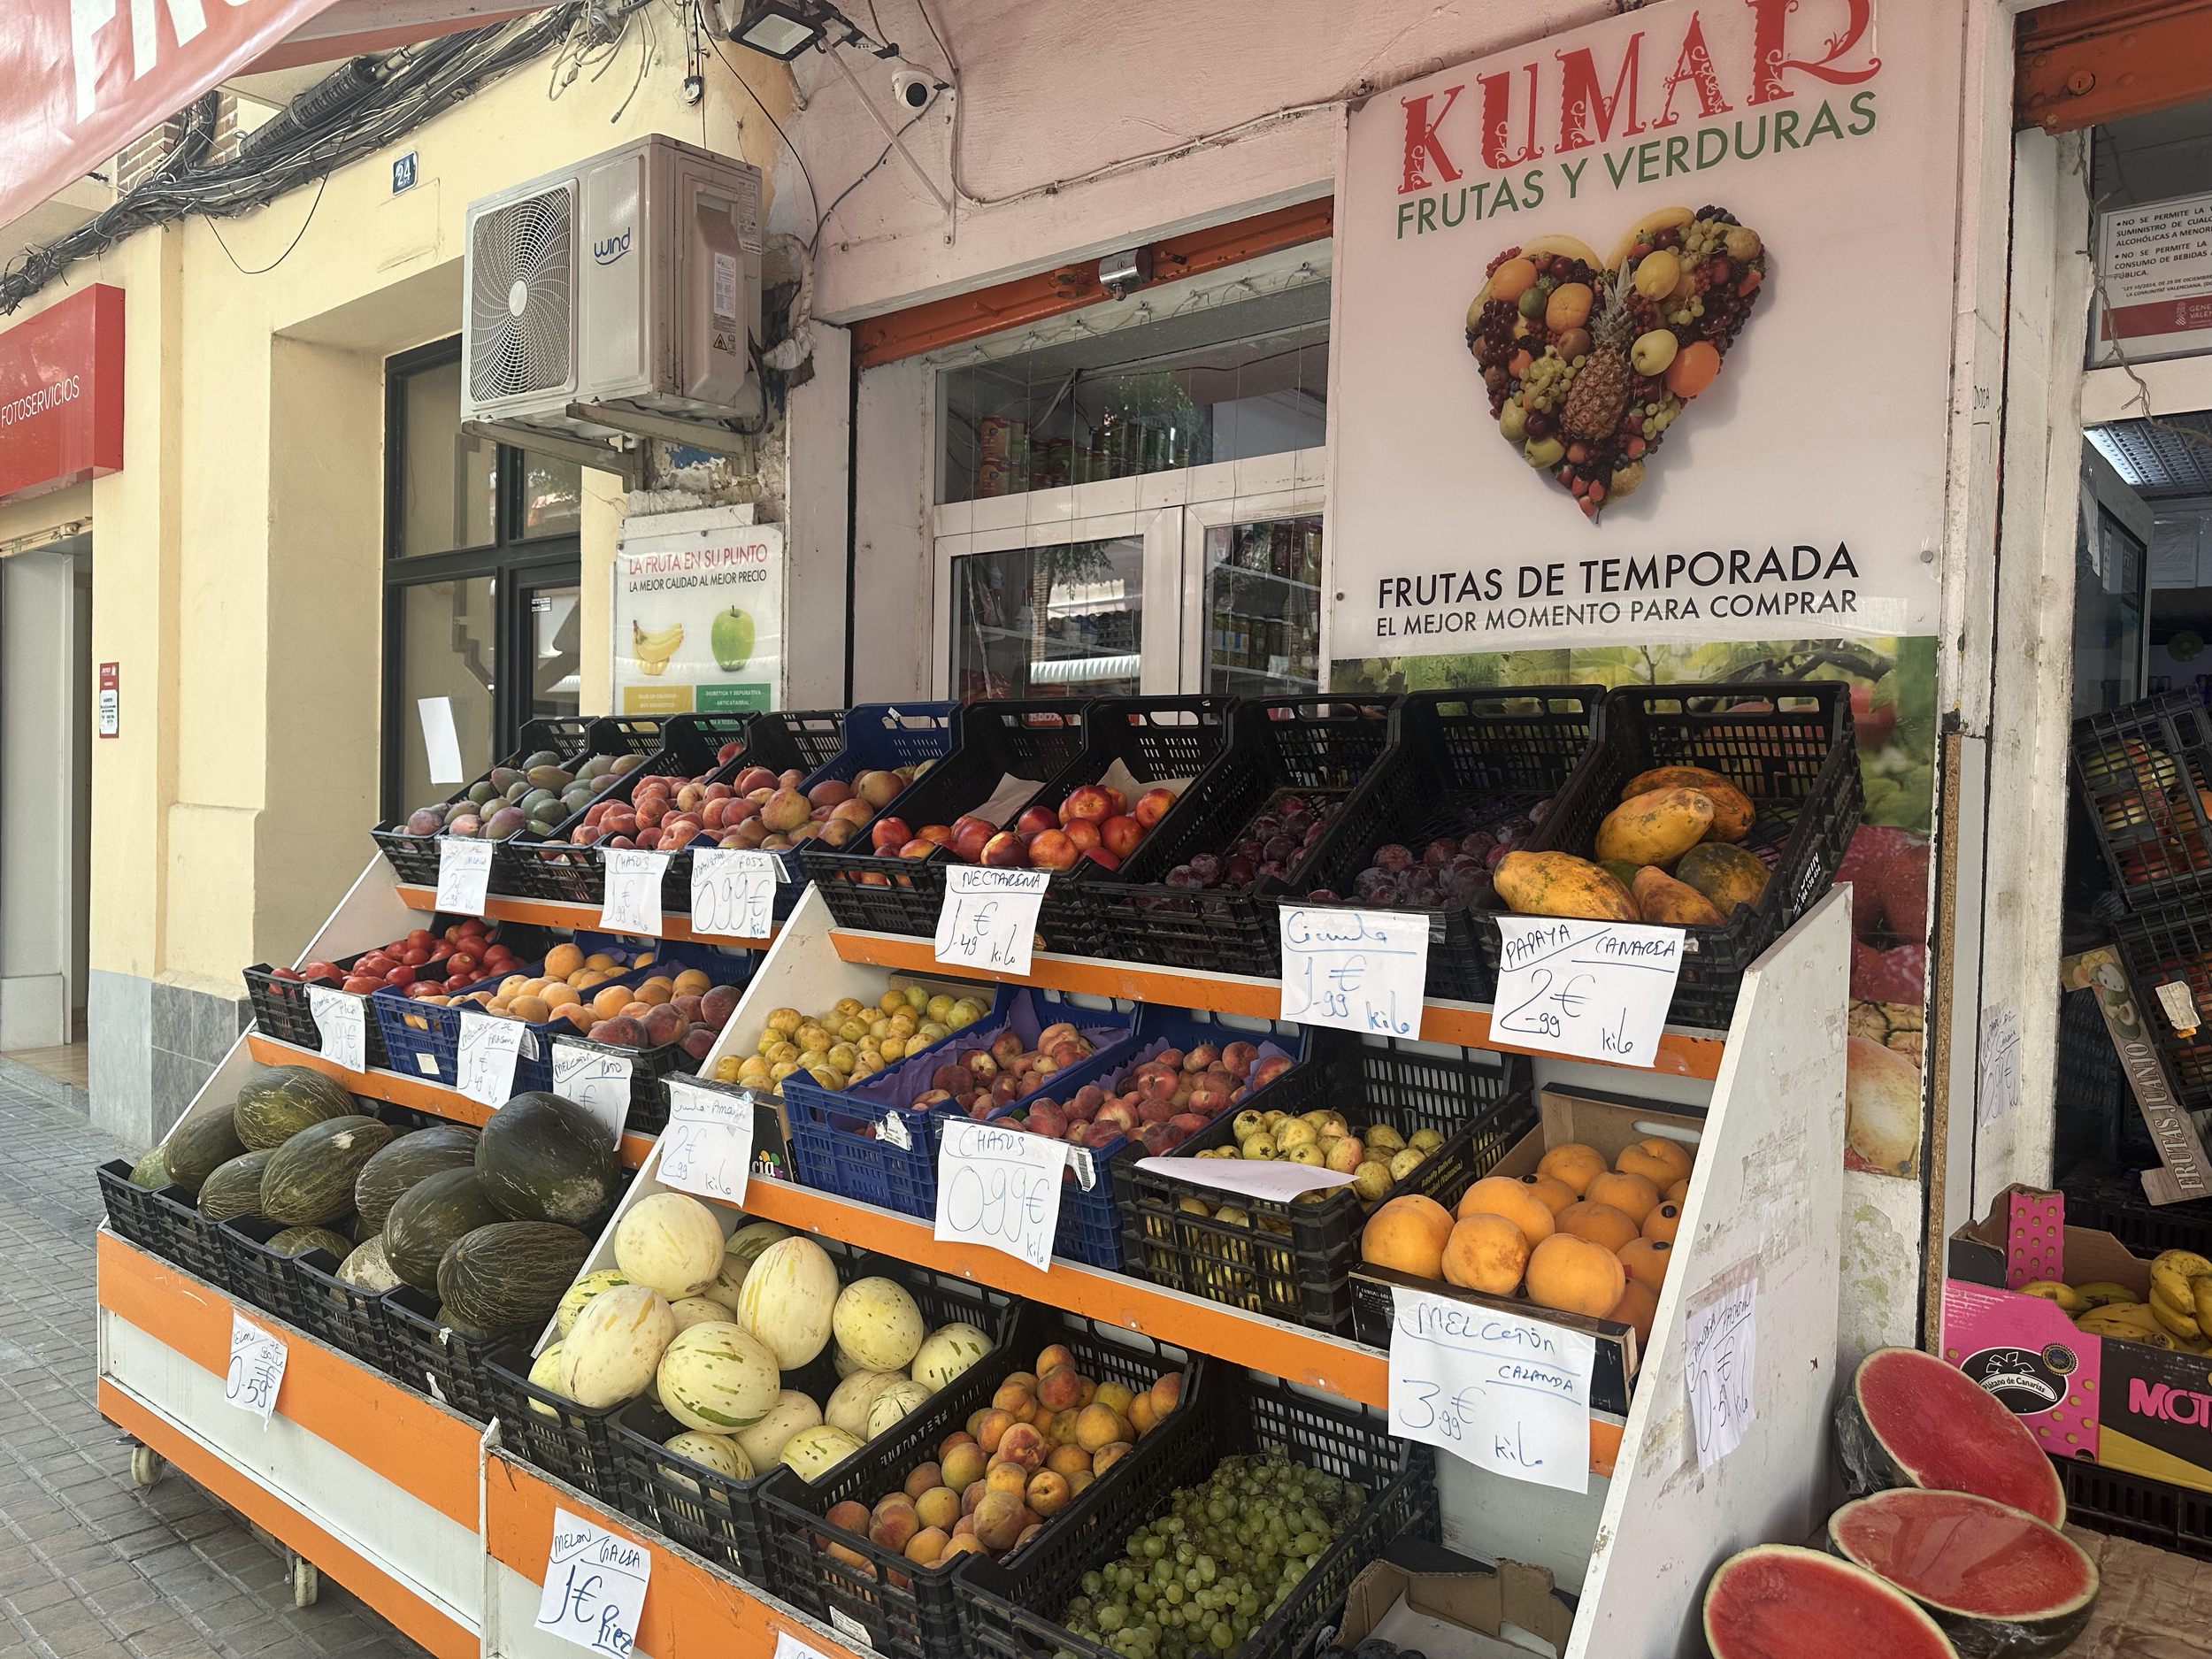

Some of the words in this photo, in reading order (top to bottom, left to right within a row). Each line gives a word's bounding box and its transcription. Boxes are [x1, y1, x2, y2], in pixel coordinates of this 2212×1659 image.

[1396, 0, 1882, 196] KUMAR
[396, 159, 411, 186] 24
[1396, 171, 1544, 240] FRUTAS
[1561, 158, 1587, 200] Y
[1603, 91, 1877, 189] VERDURAS
[2116, 223, 2166, 237] SUMINISTRO
[2154, 209, 2189, 221] PERMITE
[2114, 257, 2156, 270] CONSUMO
[2173, 250, 2208, 261] BEBIDAS
[2116, 232, 2170, 247] ALCOHÓLICAS
[2155, 242, 2191, 254] PERMITE
[1, 374, 80, 428] FOTOSERVICIOS
[629, 558, 642, 575] LA
[645, 553, 681, 574] FRUTA
[684, 550, 702, 571] EN
[704, 549, 720, 568] SU
[723, 543, 768, 565] PUNTO
[1378, 569, 1503, 609] FRUTAS
[1518, 563, 1564, 598] DE
[1578, 541, 1859, 594] TEMPORADA
[629, 580, 638, 592] LA
[640, 578, 664, 592] MEJOR
[665, 575, 698, 589] CALIDAD
[699, 574, 709, 586] AL
[710, 572, 737, 586] MEJOR
[739, 569, 767, 583] PRECIO
[1377, 618, 1396, 637] EL
[1403, 610, 1477, 636] MEJOR
[1484, 602, 1621, 632] MOMENTO
[1631, 596, 1700, 623] PARA
[1709, 588, 1857, 618] COMPRAR
[991, 924, 1017, 965] kilo
[1506, 924, 1571, 969] PAPAYA
[1365, 990, 1410, 1034] kilo
[1602, 1007, 1633, 1054] kilo
[2124, 1042, 2177, 1113] JUANJO
[2154, 1117, 2205, 1191] FRUTAS
[1025, 1233, 1044, 1265] kilo
[2016, 1377, 2046, 1393] Canarias
[2128, 1378, 2212, 1428] MOT
[555, 1528, 591, 1556] MELON
